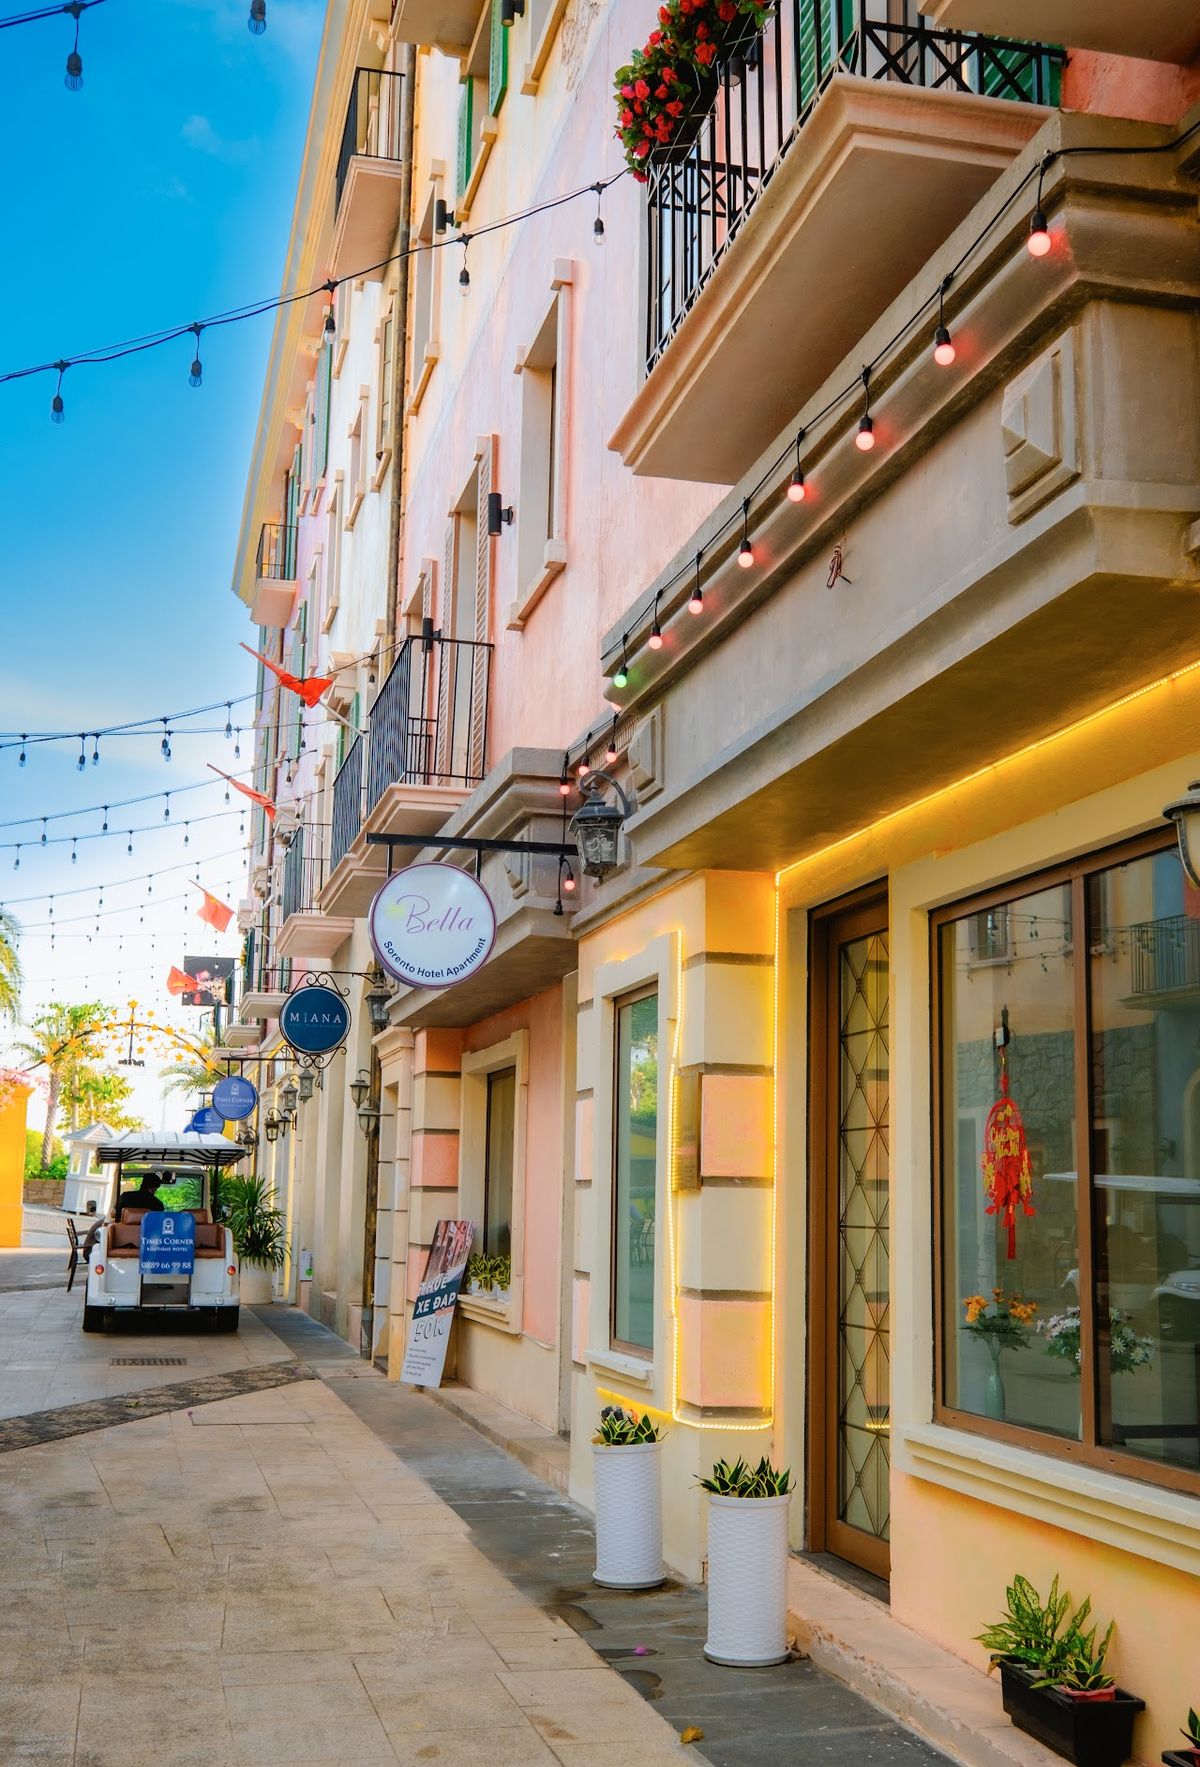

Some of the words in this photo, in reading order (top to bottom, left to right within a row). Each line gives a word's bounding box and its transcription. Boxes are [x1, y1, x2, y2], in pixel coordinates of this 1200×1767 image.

[396, 894, 475, 934] Bella
[383, 940, 416, 973] Sorento
[416, 966, 445, 978] Hotel
[446, 937, 487, 977] Apartment
[141, 1237, 163, 1245] TIMES
[163, 1237, 194, 1245] CORNER
[141, 1261, 160, 1269] 0889
[160, 1261, 171, 1269] 66
[171, 1261, 181, 1269] 99
[181, 1261, 192, 1269] 88
[415, 1298, 431, 1315] XE
[432, 1292, 457, 1311] ĐẠP
[413, 1317, 445, 1342] 50K
